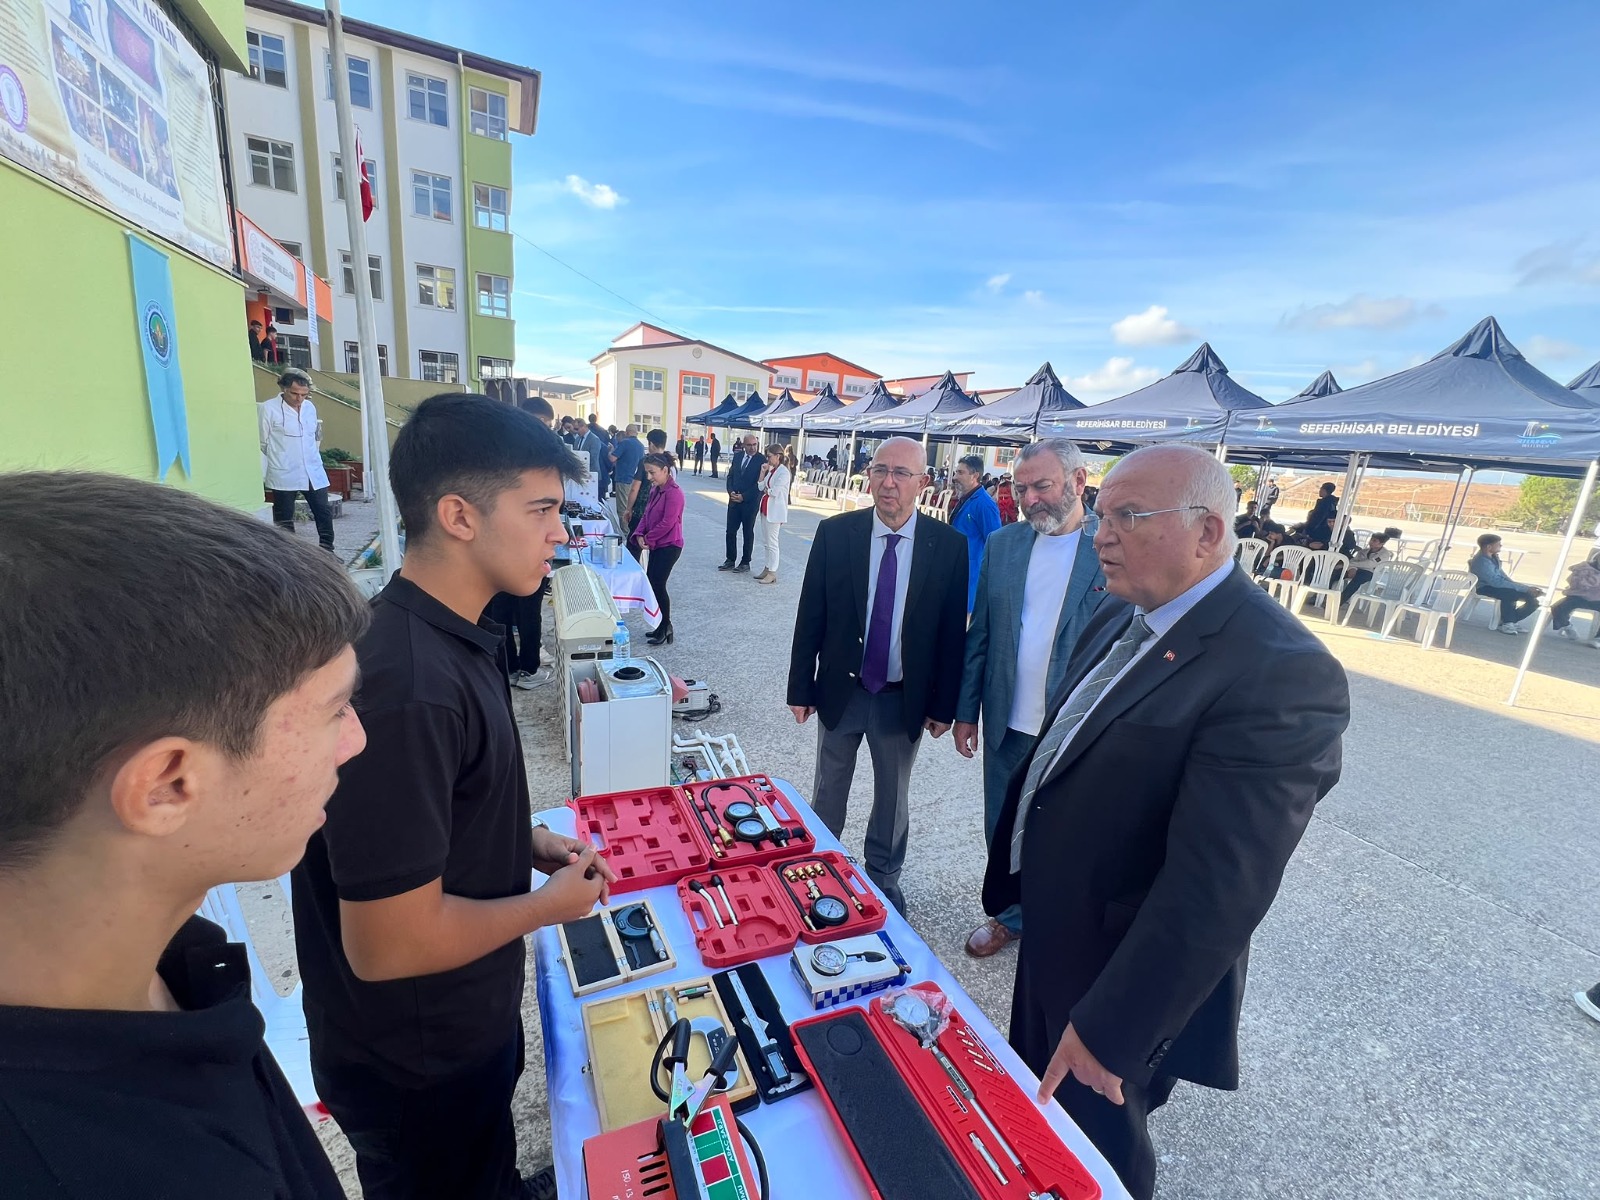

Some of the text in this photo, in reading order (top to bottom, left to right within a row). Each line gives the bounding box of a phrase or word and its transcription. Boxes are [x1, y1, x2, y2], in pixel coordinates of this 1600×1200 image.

[1076, 419, 1166, 429] SEFERİHİSAR BELEDİYESİ
[1299, 422, 1480, 437] SEFERİHİSAR BELEDİYESİ
